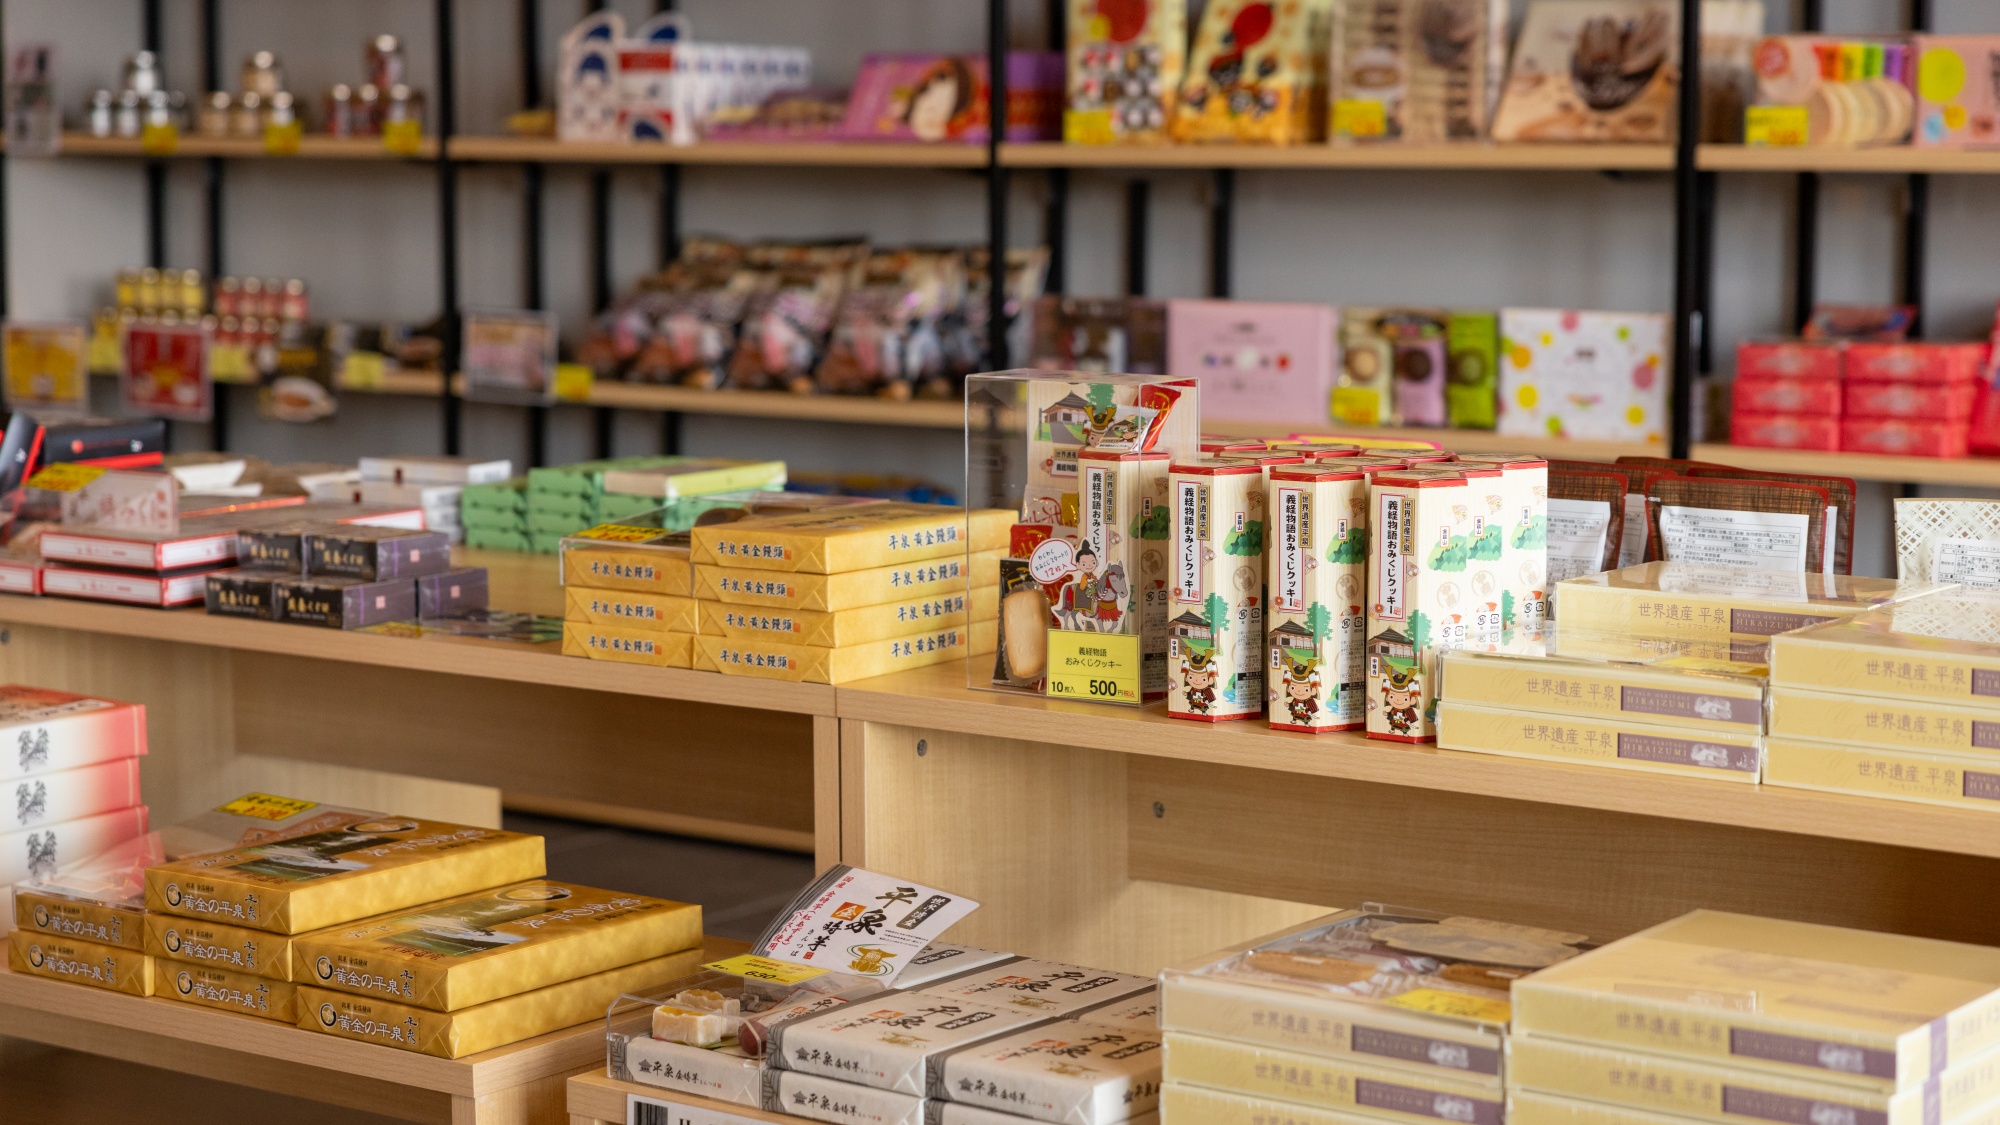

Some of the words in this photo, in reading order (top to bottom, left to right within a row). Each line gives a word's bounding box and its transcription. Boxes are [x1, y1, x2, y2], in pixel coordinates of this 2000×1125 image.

[1403, 501, 1411, 552] 世界遺産平泉
[1184, 487, 1194, 598] 義経物語おみくじクッキー
[1286, 494, 1296, 606] 義経物語おみくじクッキー
[1387, 500, 1398, 615] 義経物語おみくじクッキー
[1638, 602, 1694, 621] 世界遺産
[1698, 606, 1727, 623] 平泉
[1736, 618, 1799, 629] HIRAIZUMI
[1065, 657, 1122, 668] おみくじクッキー
[1078, 647, 1107, 657] 義経物語
[1865, 659, 1928, 681] 世界遺産
[1934, 665, 1966, 684] 平泉
[1526, 678, 1582, 698] 世界遺産
[1588, 683, 1616, 701] 平泉
[1627, 696, 1691, 710] HIRAIZUMI
[1522, 724, 1579, 745] 世界遺産
[1584, 731, 1613, 748] 平泉
[1864, 711, 1928, 733] 世界遺産
[1934, 717, 1966, 737] 平泉
[1624, 743, 1687, 757] HIRAIZUMI
[1857, 760, 1920, 783] 世界遺産
[1926, 768, 1958, 787] 平泉
[182, 893, 246, 920] 黄金の平泉
[49, 915, 109, 941] 黄金の平泉
[181, 940, 245, 966] 黄金の平泉
[44, 955, 104, 982] 黄金の平泉
[333, 967, 401, 996] 黄金の平泉
[193, 982, 256, 1009] 黄金の平泉
[337, 1014, 404, 1043] 黄金の平泉
